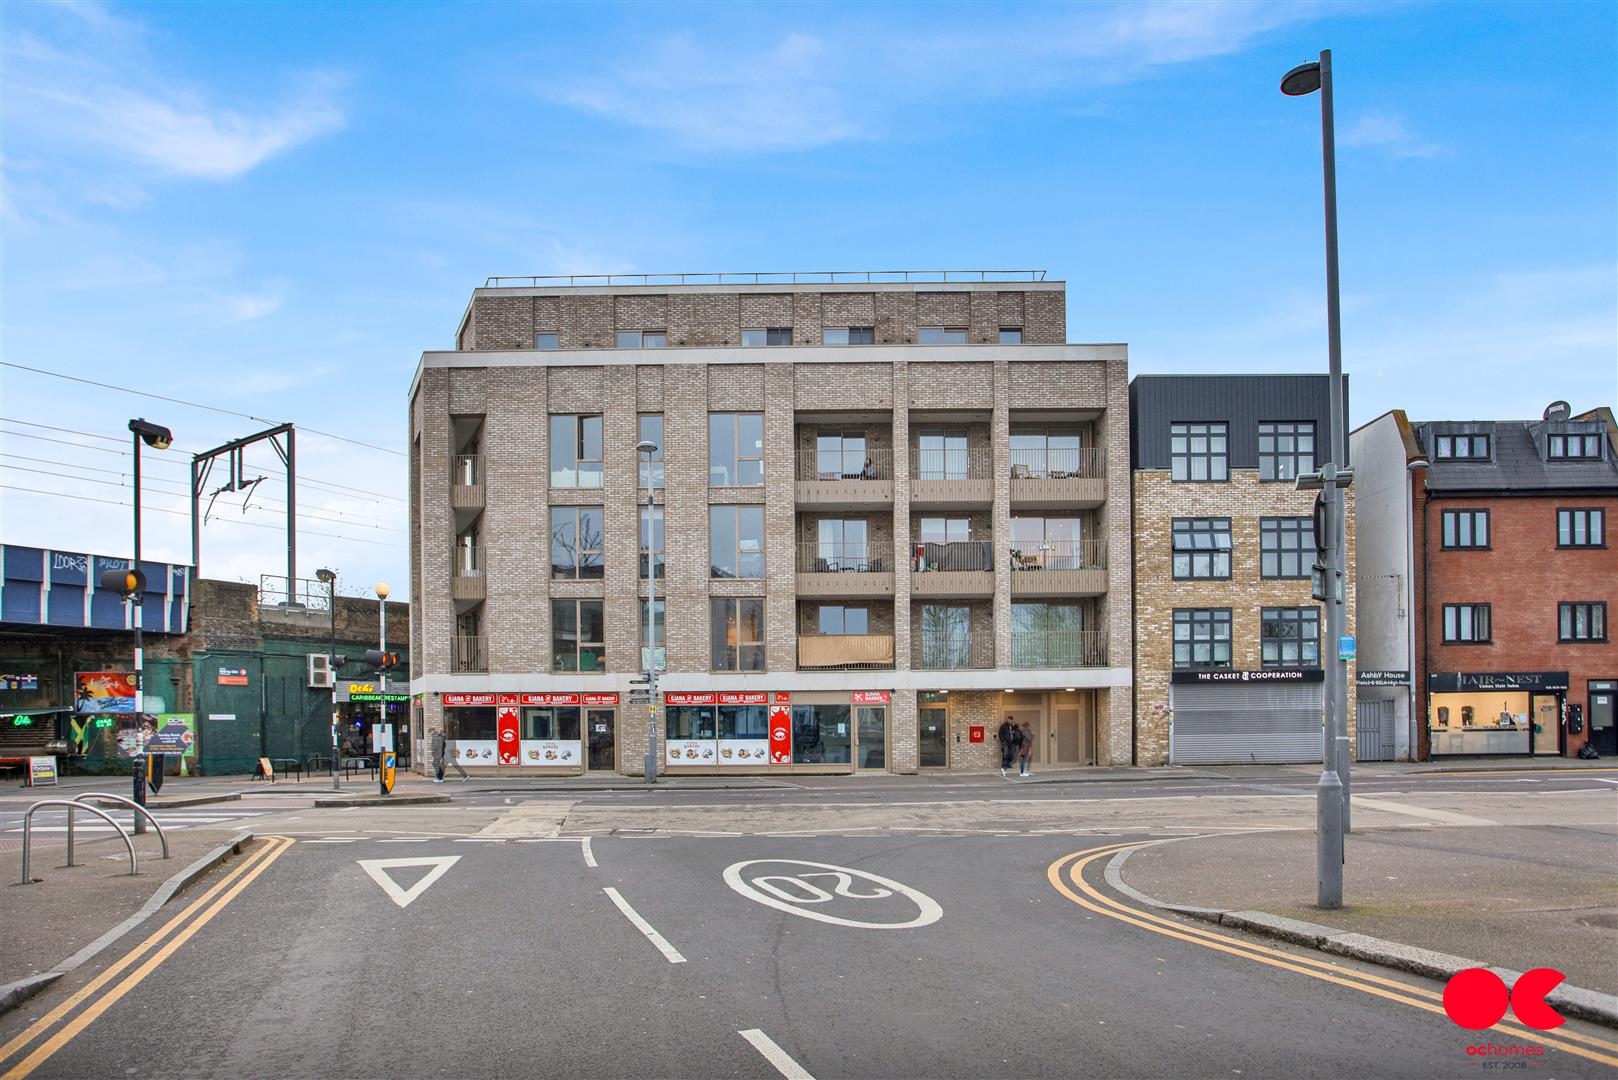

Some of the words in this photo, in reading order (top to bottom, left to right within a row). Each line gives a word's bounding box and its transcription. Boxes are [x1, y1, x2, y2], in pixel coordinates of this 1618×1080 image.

[1250, 671, 1303, 679] COOPERATION
[1383, 671, 1406, 679] House
[1505, 674, 1542, 684] NEST
[693, 694, 712, 702] BAKERY
[745, 694, 764, 702] BAKERY
